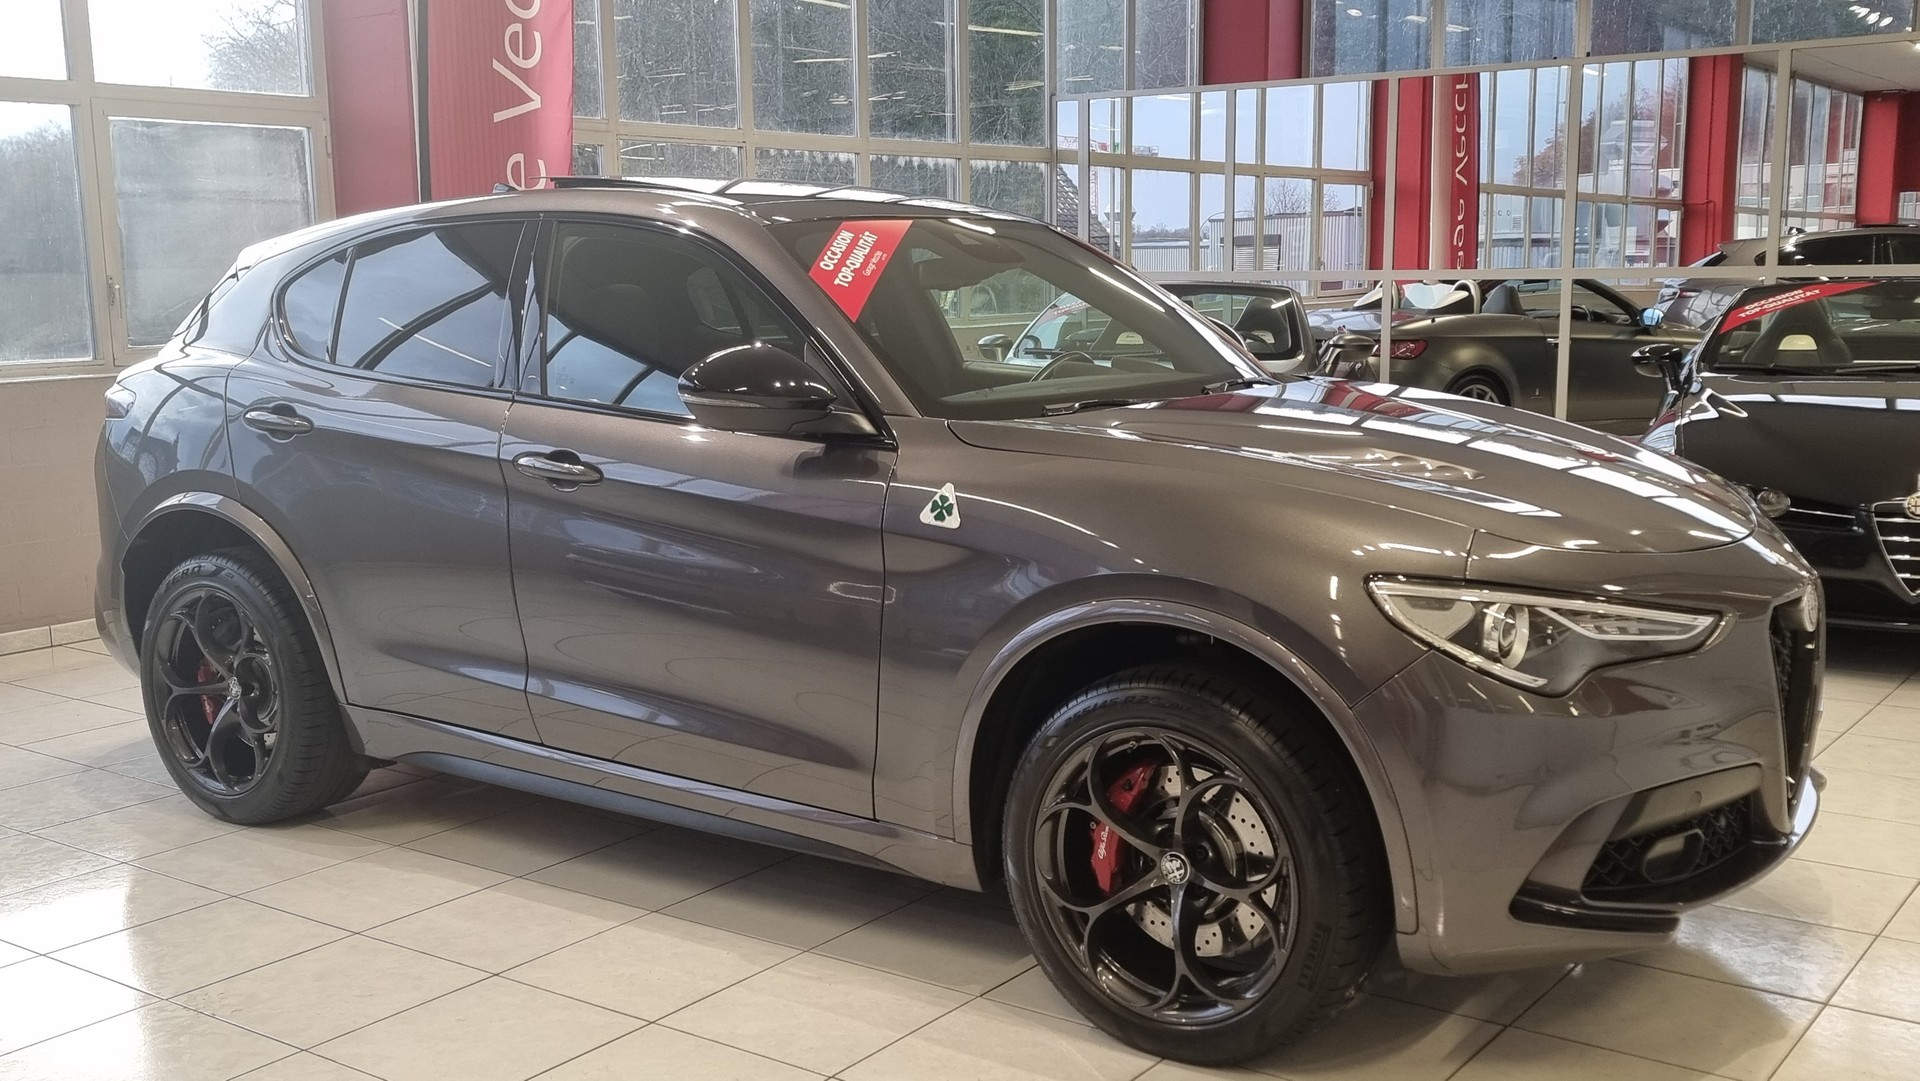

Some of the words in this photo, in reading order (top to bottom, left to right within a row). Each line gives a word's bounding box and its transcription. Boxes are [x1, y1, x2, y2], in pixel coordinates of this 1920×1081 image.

[819, 229, 855, 271] OCCASION
[833, 231, 878, 287] TOP-QUALITÄT
[1744, 290, 1803, 310] OCCASION
